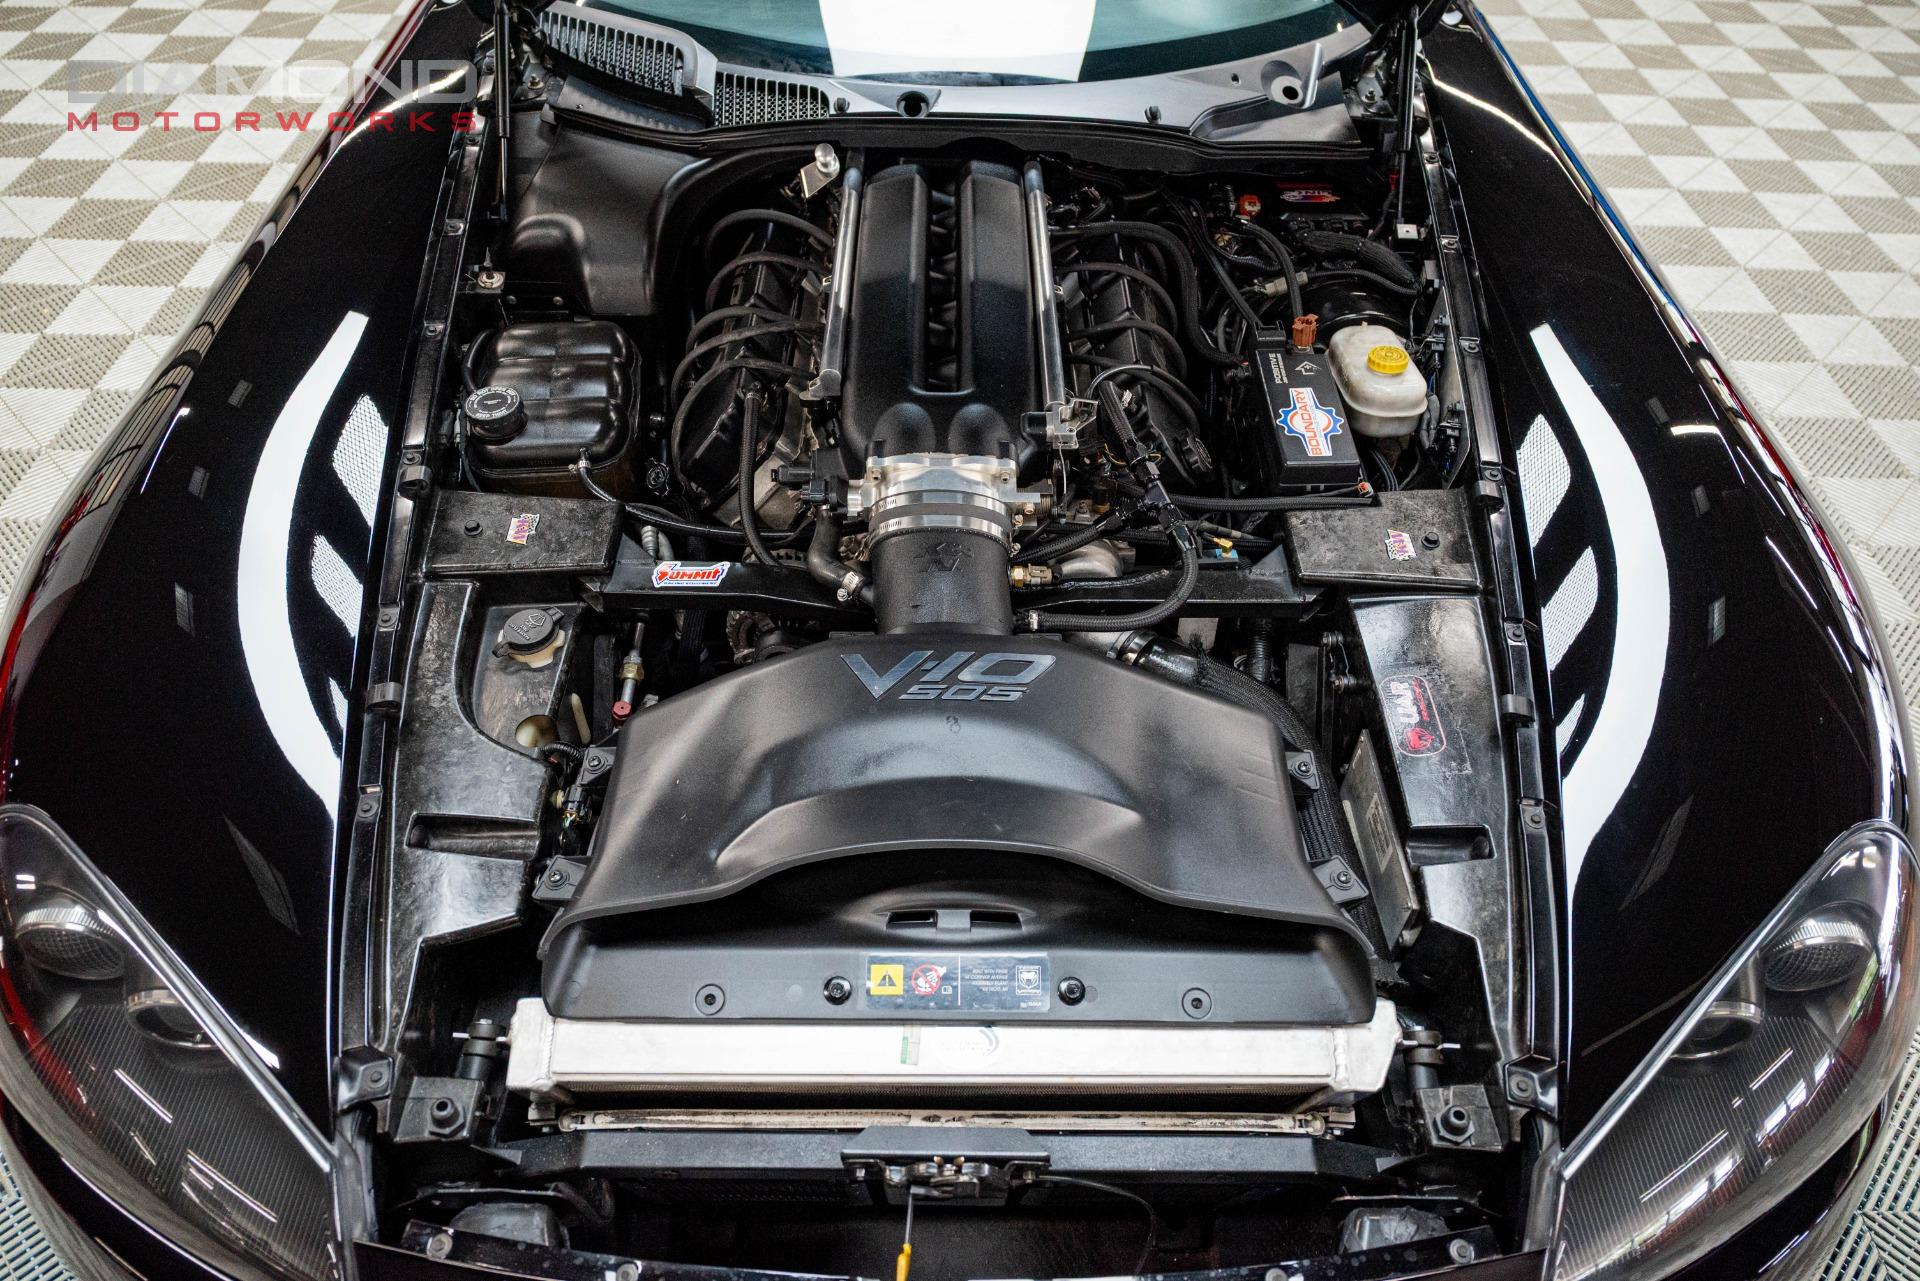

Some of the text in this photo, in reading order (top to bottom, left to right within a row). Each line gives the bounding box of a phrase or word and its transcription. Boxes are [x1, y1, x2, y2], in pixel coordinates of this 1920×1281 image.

[1269, 353, 1283, 384] POSITIVE
[1293, 389, 1322, 456] BOUNDARY
[898, 684, 1029, 702] 505
